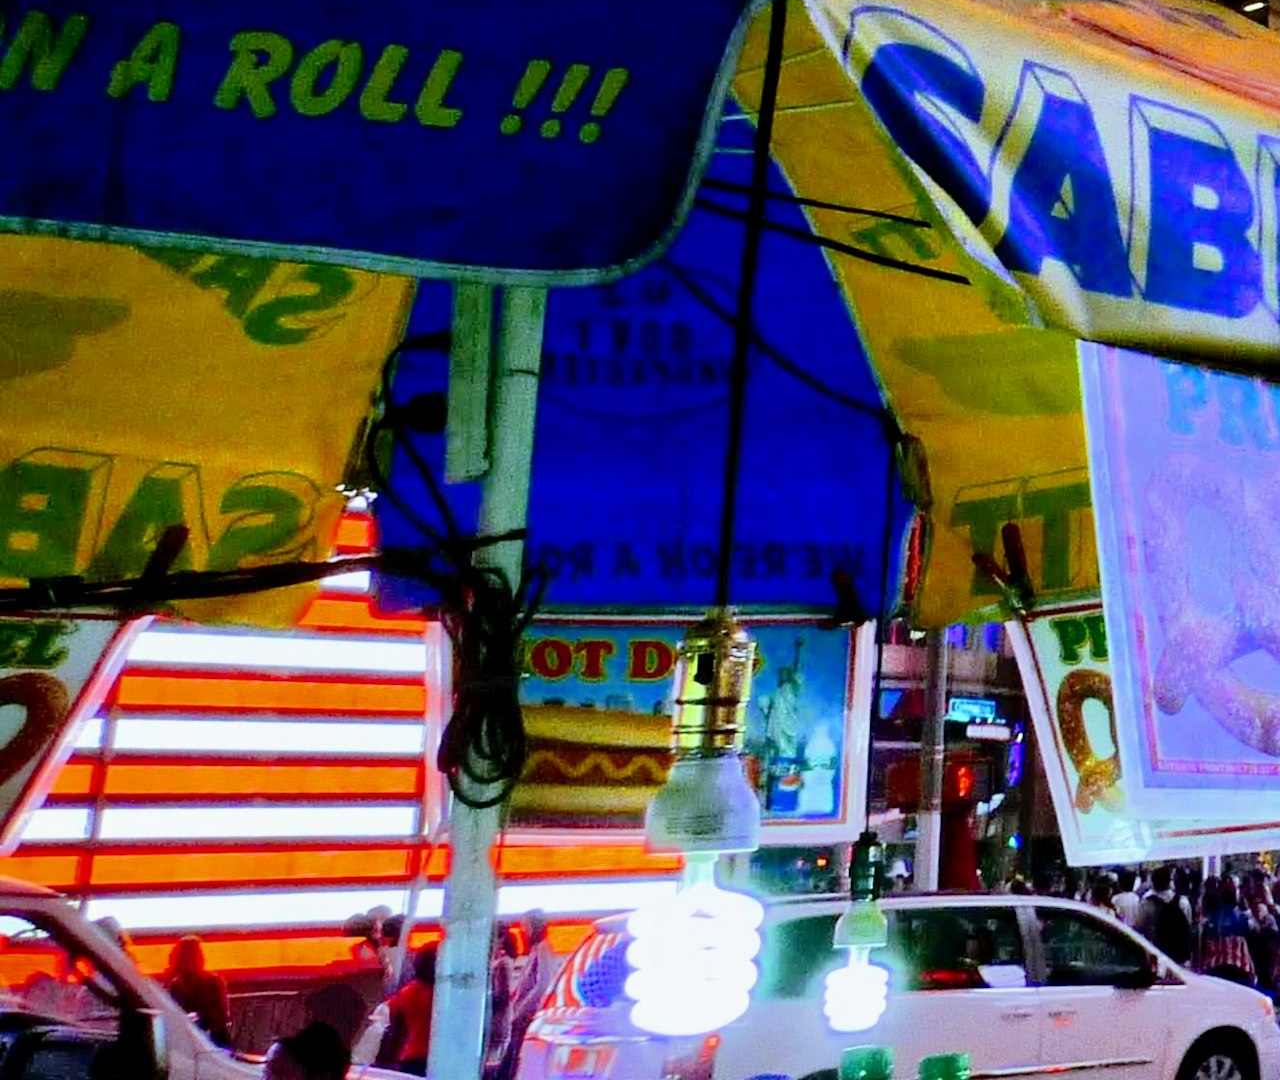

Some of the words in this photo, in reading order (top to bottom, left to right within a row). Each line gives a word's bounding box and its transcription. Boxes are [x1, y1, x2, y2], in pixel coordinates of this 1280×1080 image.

[107, 21, 181, 102] A
[214, 30, 463, 129] ROLL
[530, 637, 614, 678] OT
